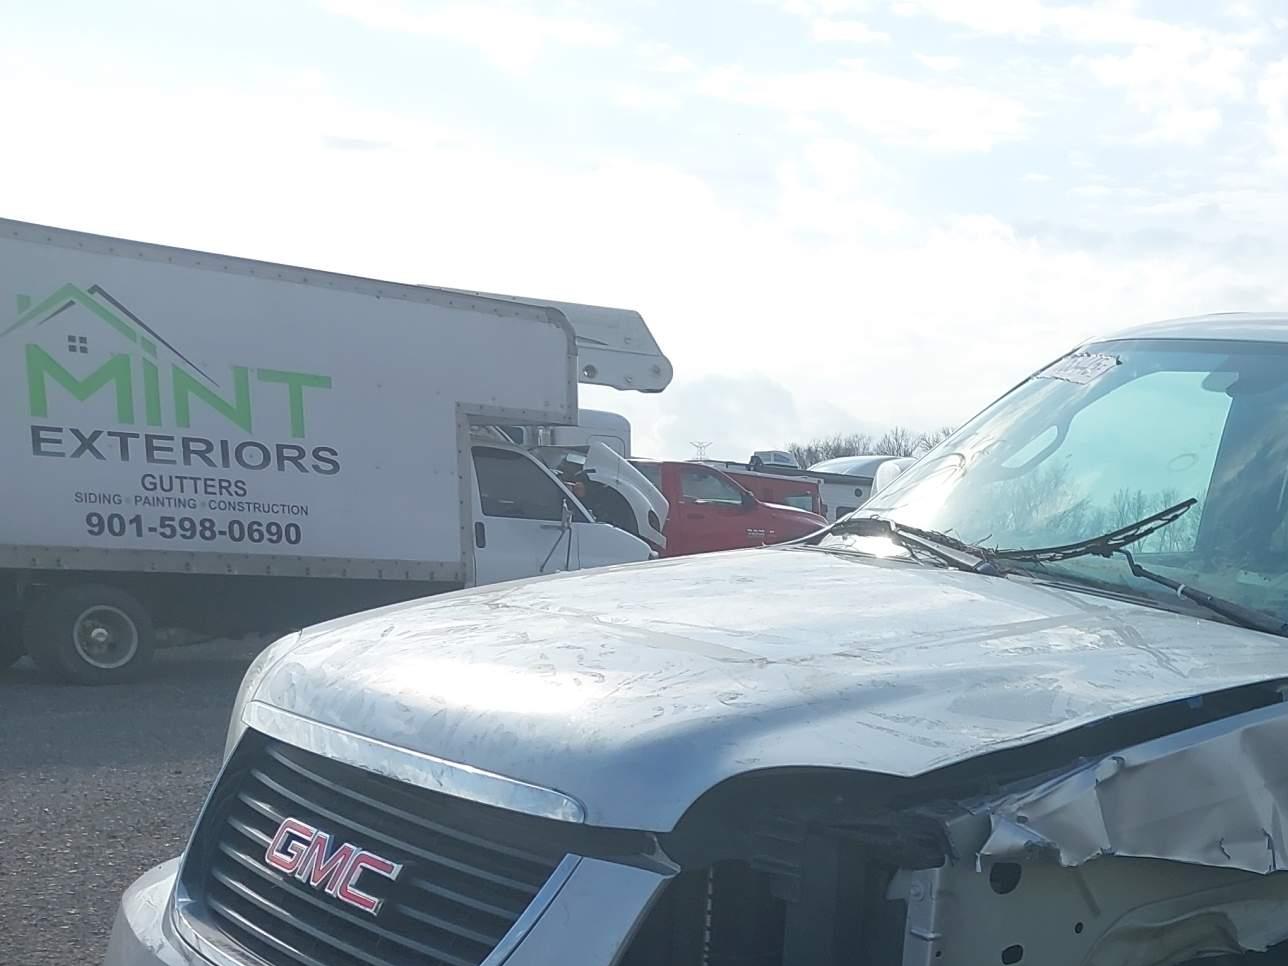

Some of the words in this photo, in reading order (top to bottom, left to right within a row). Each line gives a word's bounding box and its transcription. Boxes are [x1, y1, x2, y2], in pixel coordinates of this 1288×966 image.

[25, 343, 332, 438] MINT
[30, 425, 341, 475] EXTERIORS
[74, 491, 123, 505] SIDING
[134, 495, 197, 509] PAINTING
[208, 499, 309, 516] CONSTRUCTION
[140, 473, 248, 497] GUTTERS
[85, 512, 302, 545] 901-598-0690
[264, 816, 403, 916] GMC
